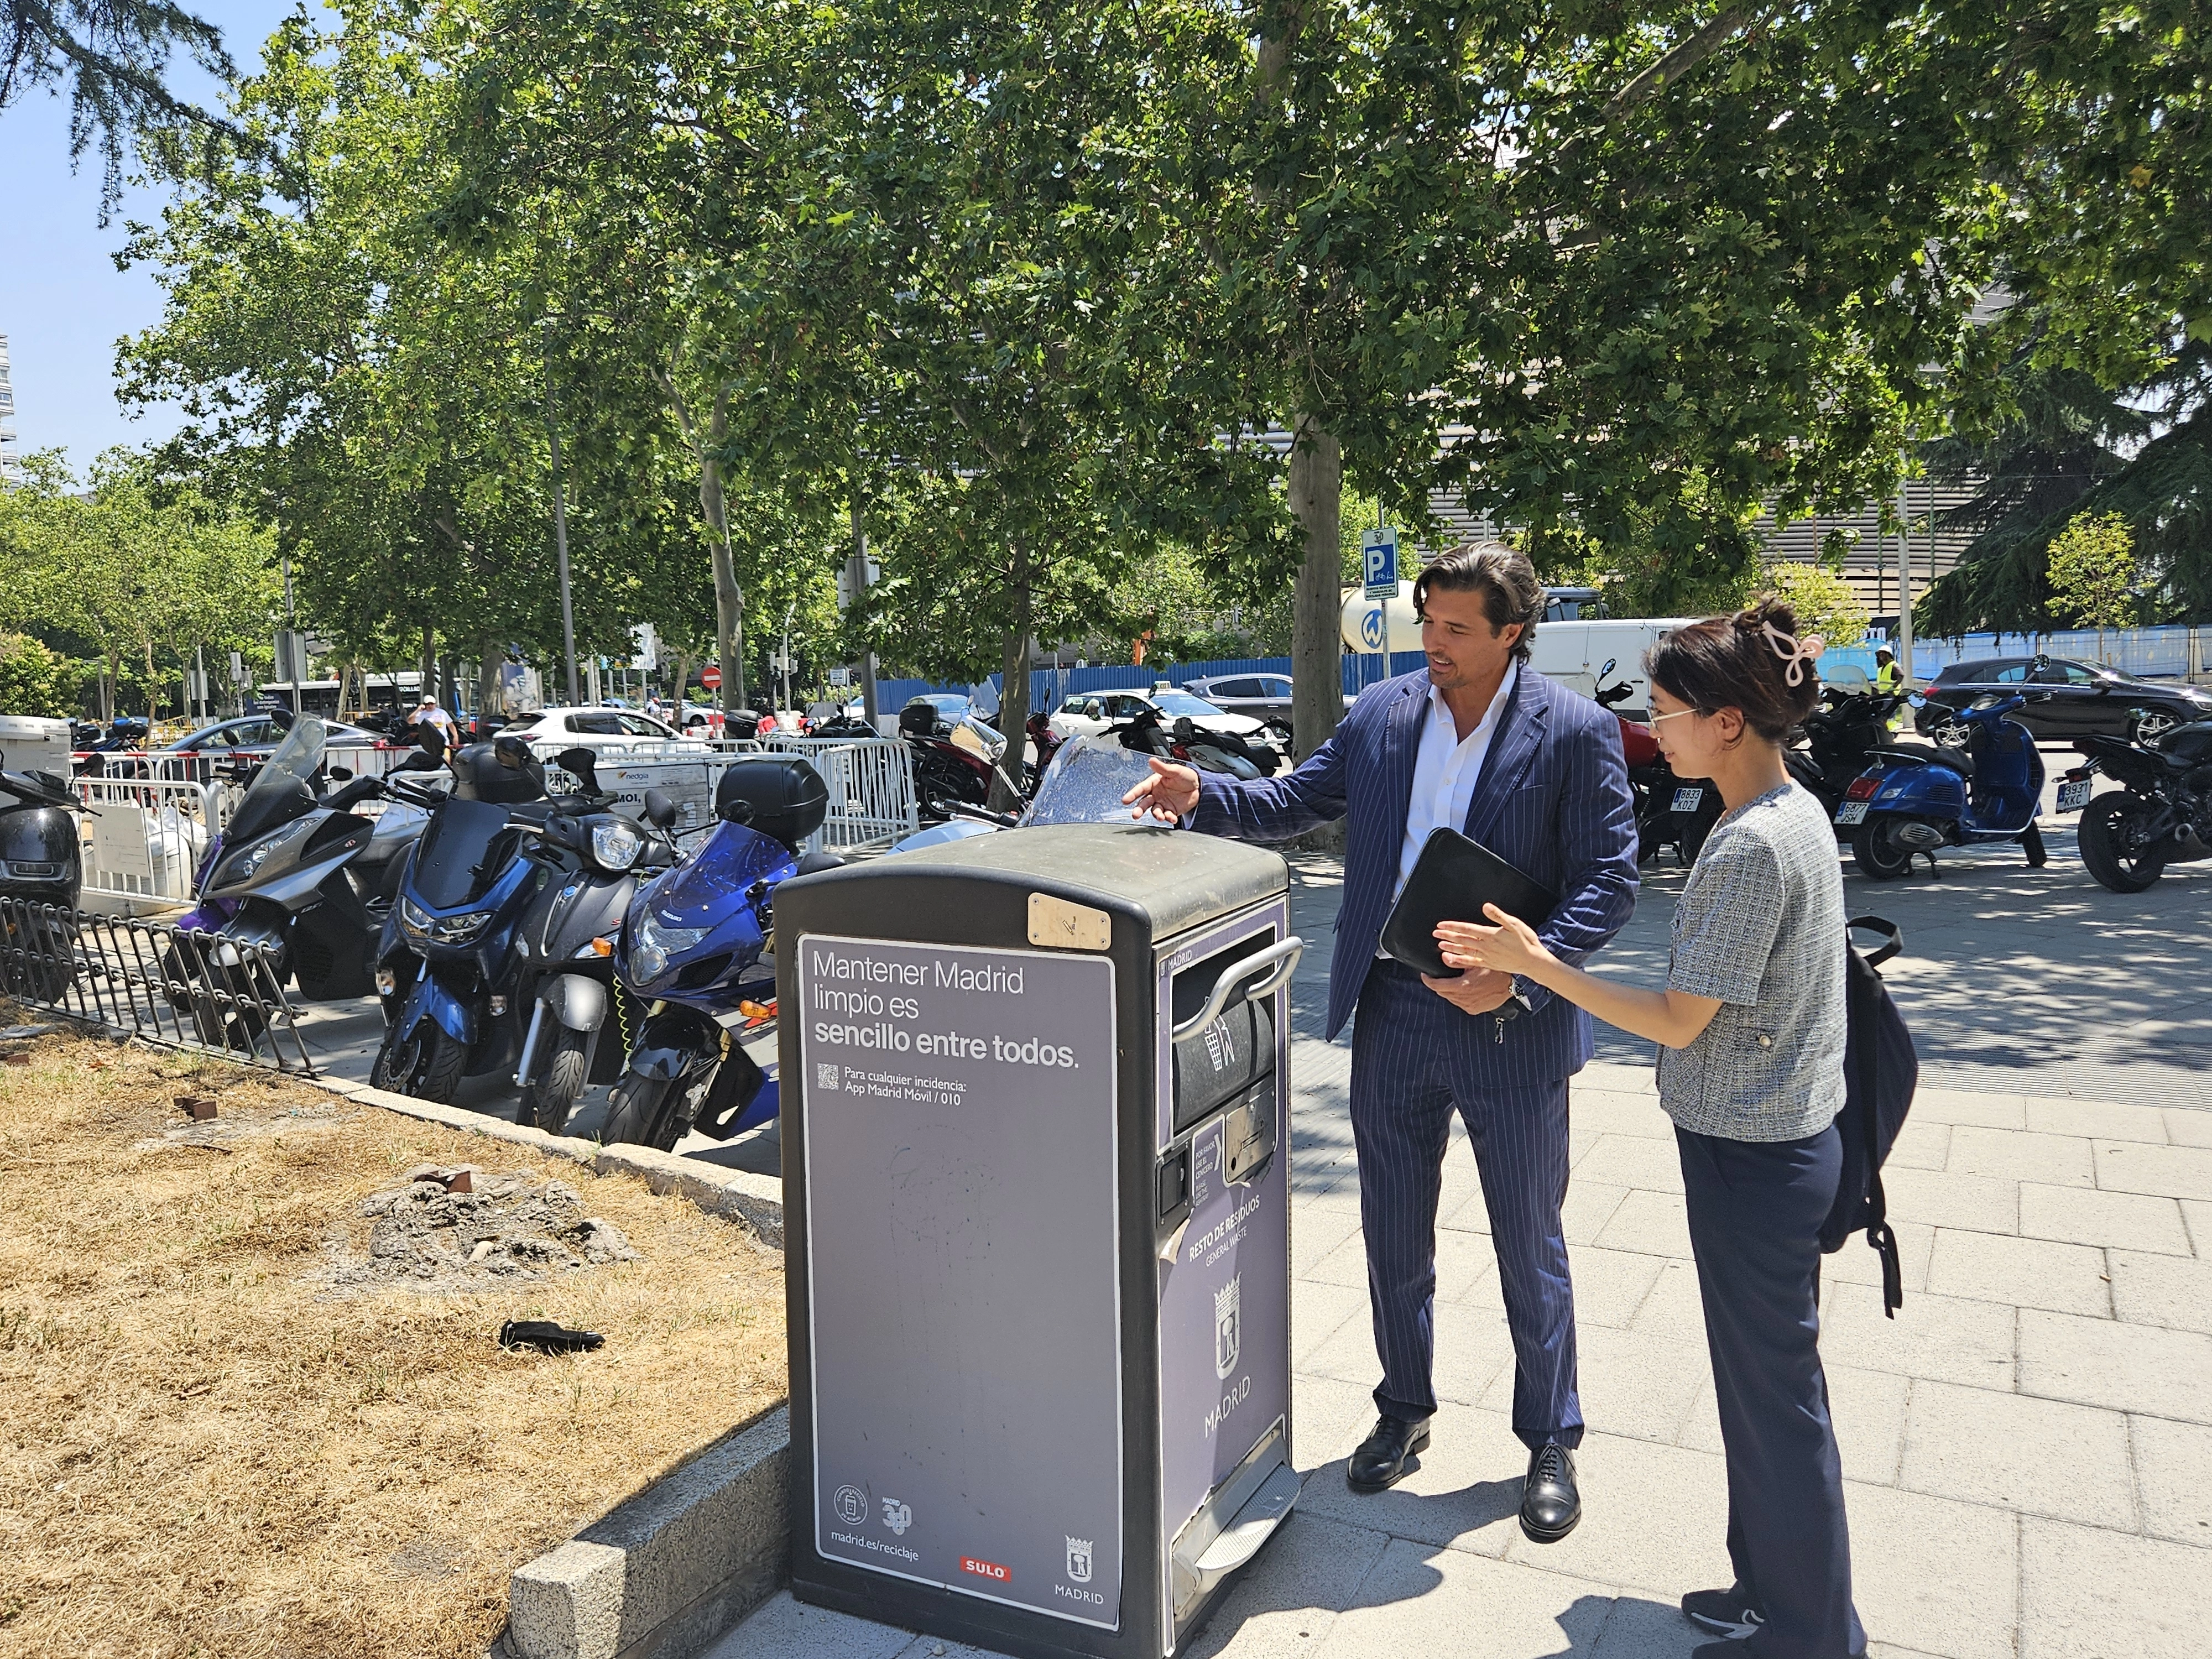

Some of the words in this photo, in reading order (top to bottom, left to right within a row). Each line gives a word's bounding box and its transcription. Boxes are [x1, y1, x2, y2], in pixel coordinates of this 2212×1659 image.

[1367, 550, 1385, 582] P
[1681, 790, 1700, 800] 8833
[2065, 781, 2088, 796] 3931
[1677, 800, 1694, 810] KDZ
[1845, 804, 1867, 813] 6877
[2064, 794, 2082, 806] KKC
[1841, 813, 1858, 823] JSH
[661, 909, 682, 922] SUZUKI
[1167, 950, 1192, 971] MADRID
[813, 951, 928, 985] Mantener
[935, 961, 1024, 994] Madrid
[815, 983, 884, 1019] limpio
[889, 997, 919, 1019] es
[815, 1022, 911, 1052] sencillo
[916, 1031, 988, 1060] entre
[992, 1035, 1079, 1068] todos.
[844, 1066, 865, 1080] Para
[868, 1071, 912, 1086] cualquier
[914, 1076, 967, 1092] incidencia:
[844, 1081, 865, 1097] App
[868, 1083, 901, 1098] Madrid
[904, 1088, 932, 1103] Móvil
[941, 1092, 961, 1106] 010
[1195, 1148, 1203, 1160] POR
[1203, 1140, 1216, 1155] FAVOR
[1203, 1155, 1207, 1165] EL
[1195, 1161, 1213, 1180] CENICERO
[1189, 1232, 1213, 1262] RESTO
[1214, 1222, 1225, 1241] DE
[1225, 1194, 1260, 1233] RESIDUOS
[1206, 1240, 1230, 1267] GENERAL
[1230, 1225, 1247, 1247] WASTE
[1206, 1375, 1250, 1438] MADRID
[882, 1497, 901, 1507] MADRID
[831, 1531, 920, 1562] madrid.es/reciclaje
[966, 1560, 1005, 1578] SULO
[1055, 1584, 1104, 1604] MADRID
